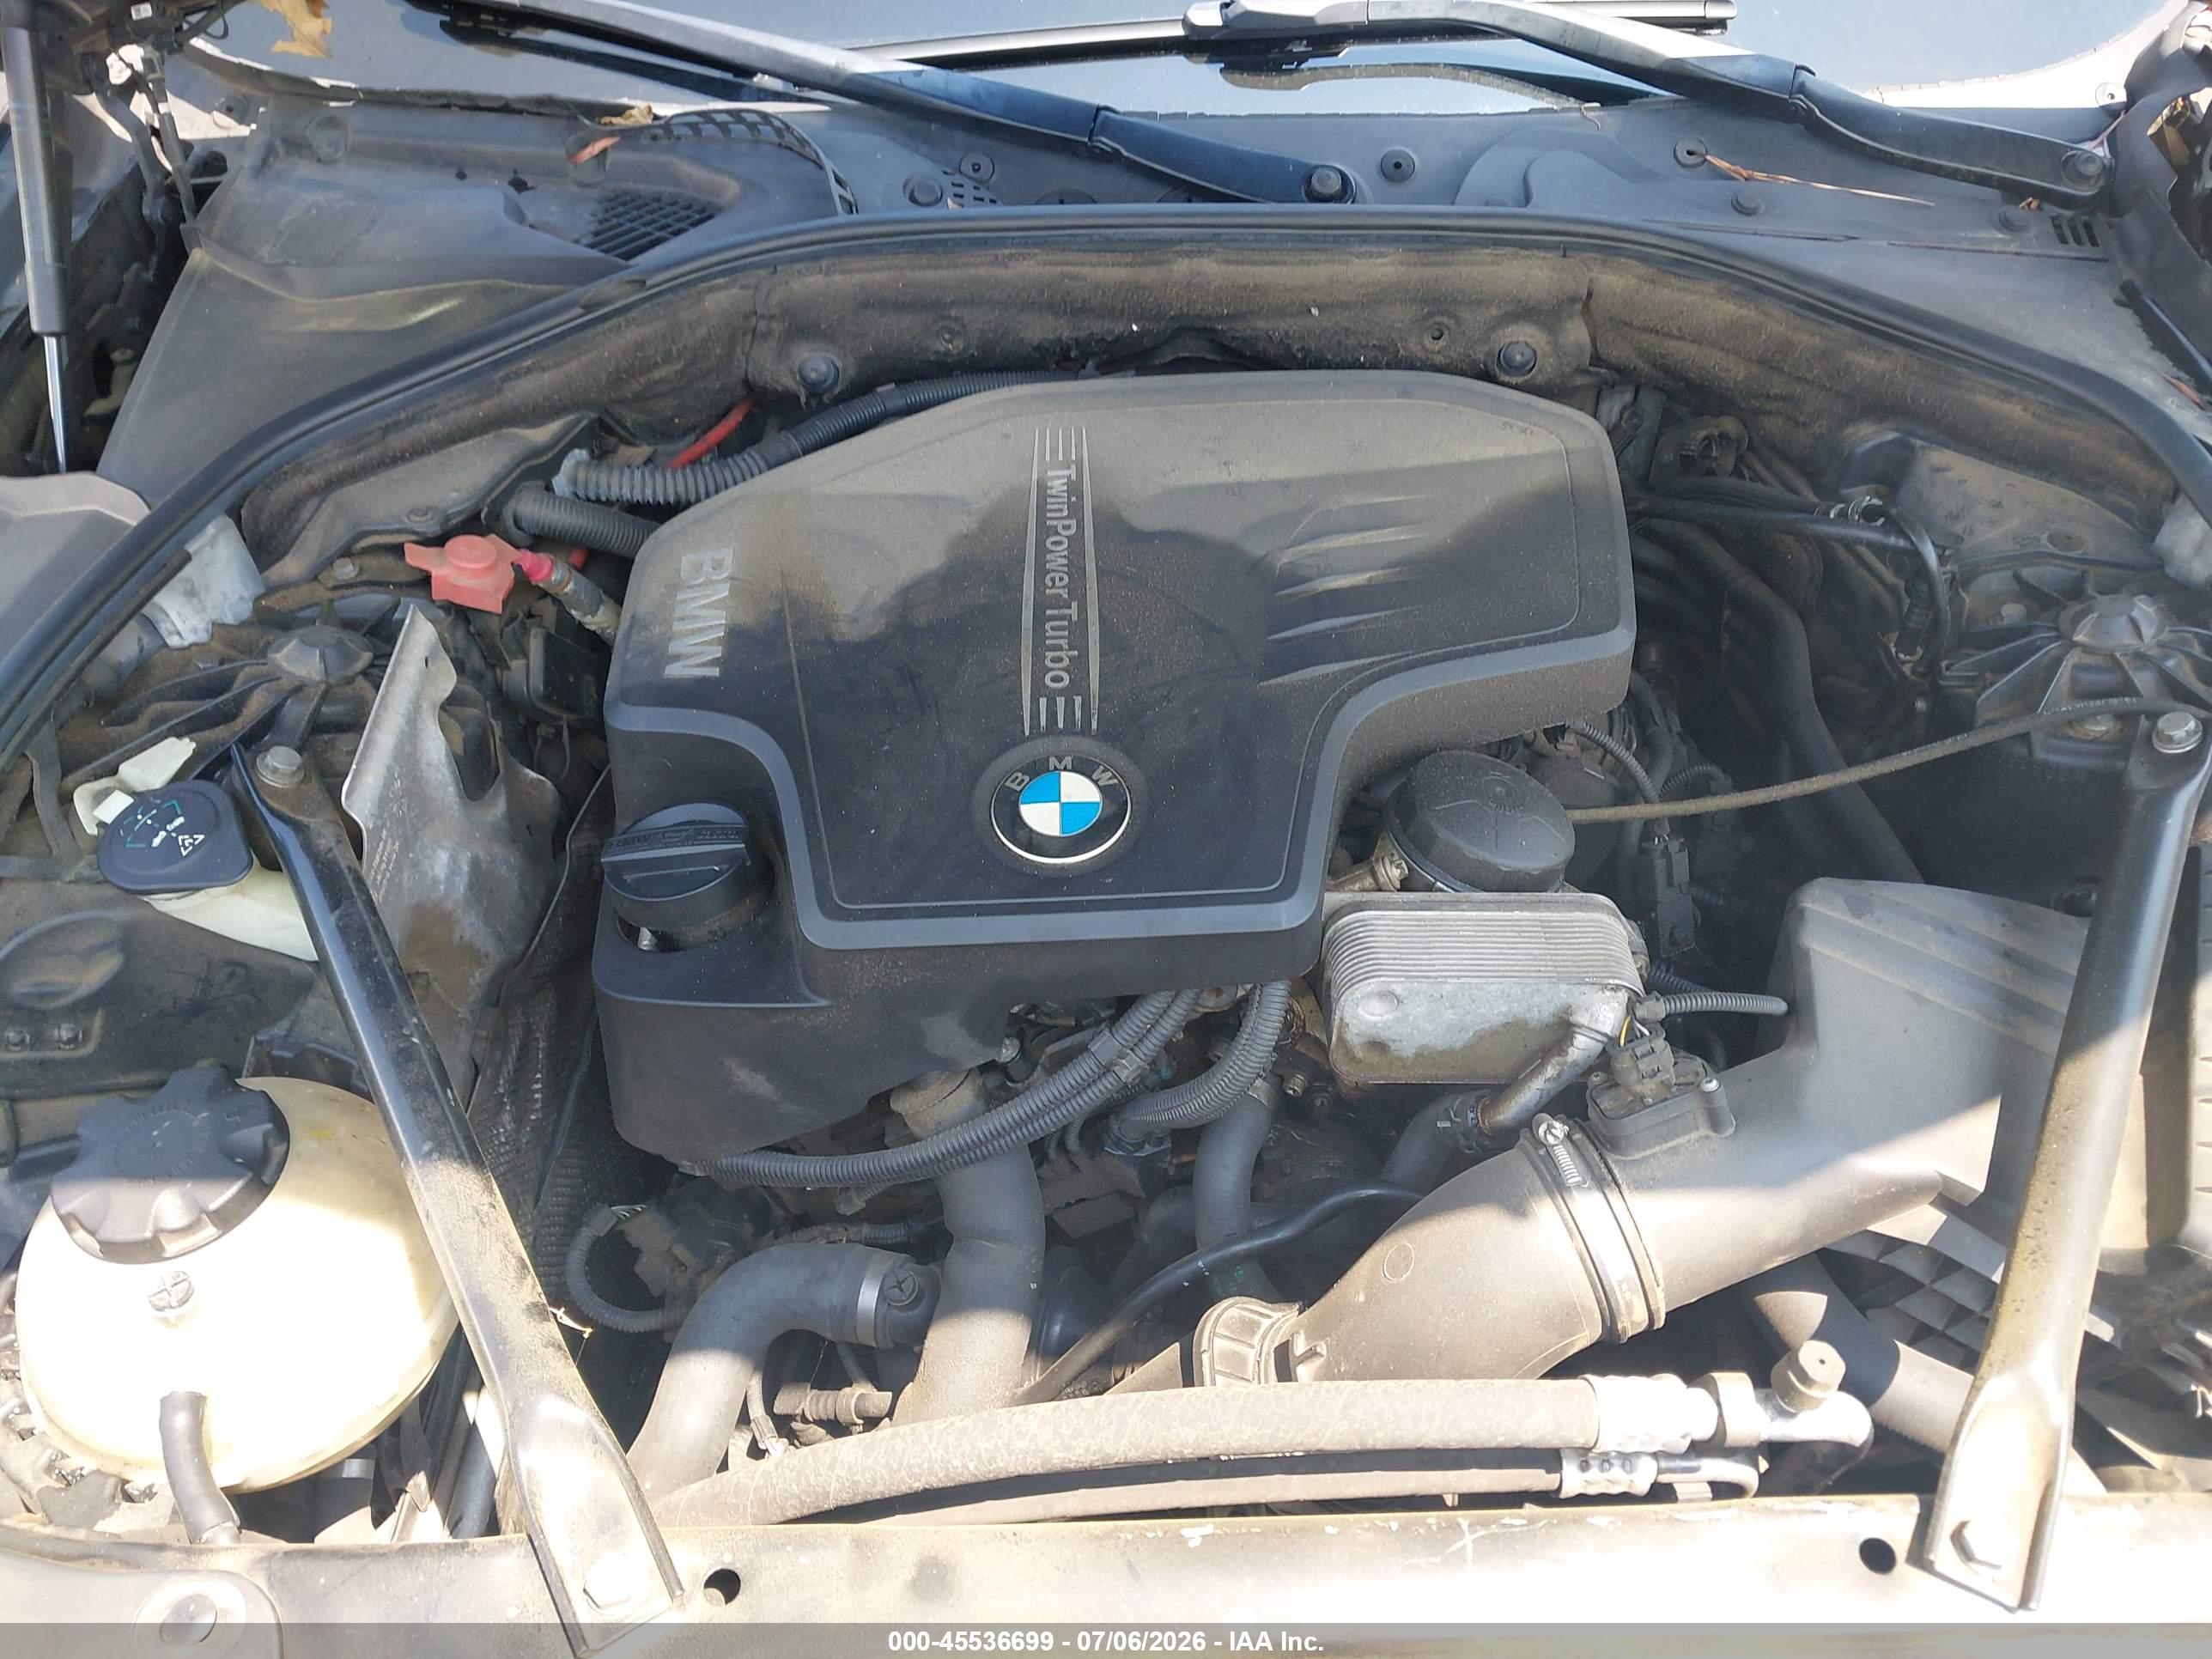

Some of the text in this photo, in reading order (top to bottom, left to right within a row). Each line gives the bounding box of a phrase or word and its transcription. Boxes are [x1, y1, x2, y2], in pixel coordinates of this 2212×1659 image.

[664, 548, 733, 678] BMW
[1045, 464, 1079, 688] TwinPower Turbo
[1005, 756, 1119, 792] BMW
